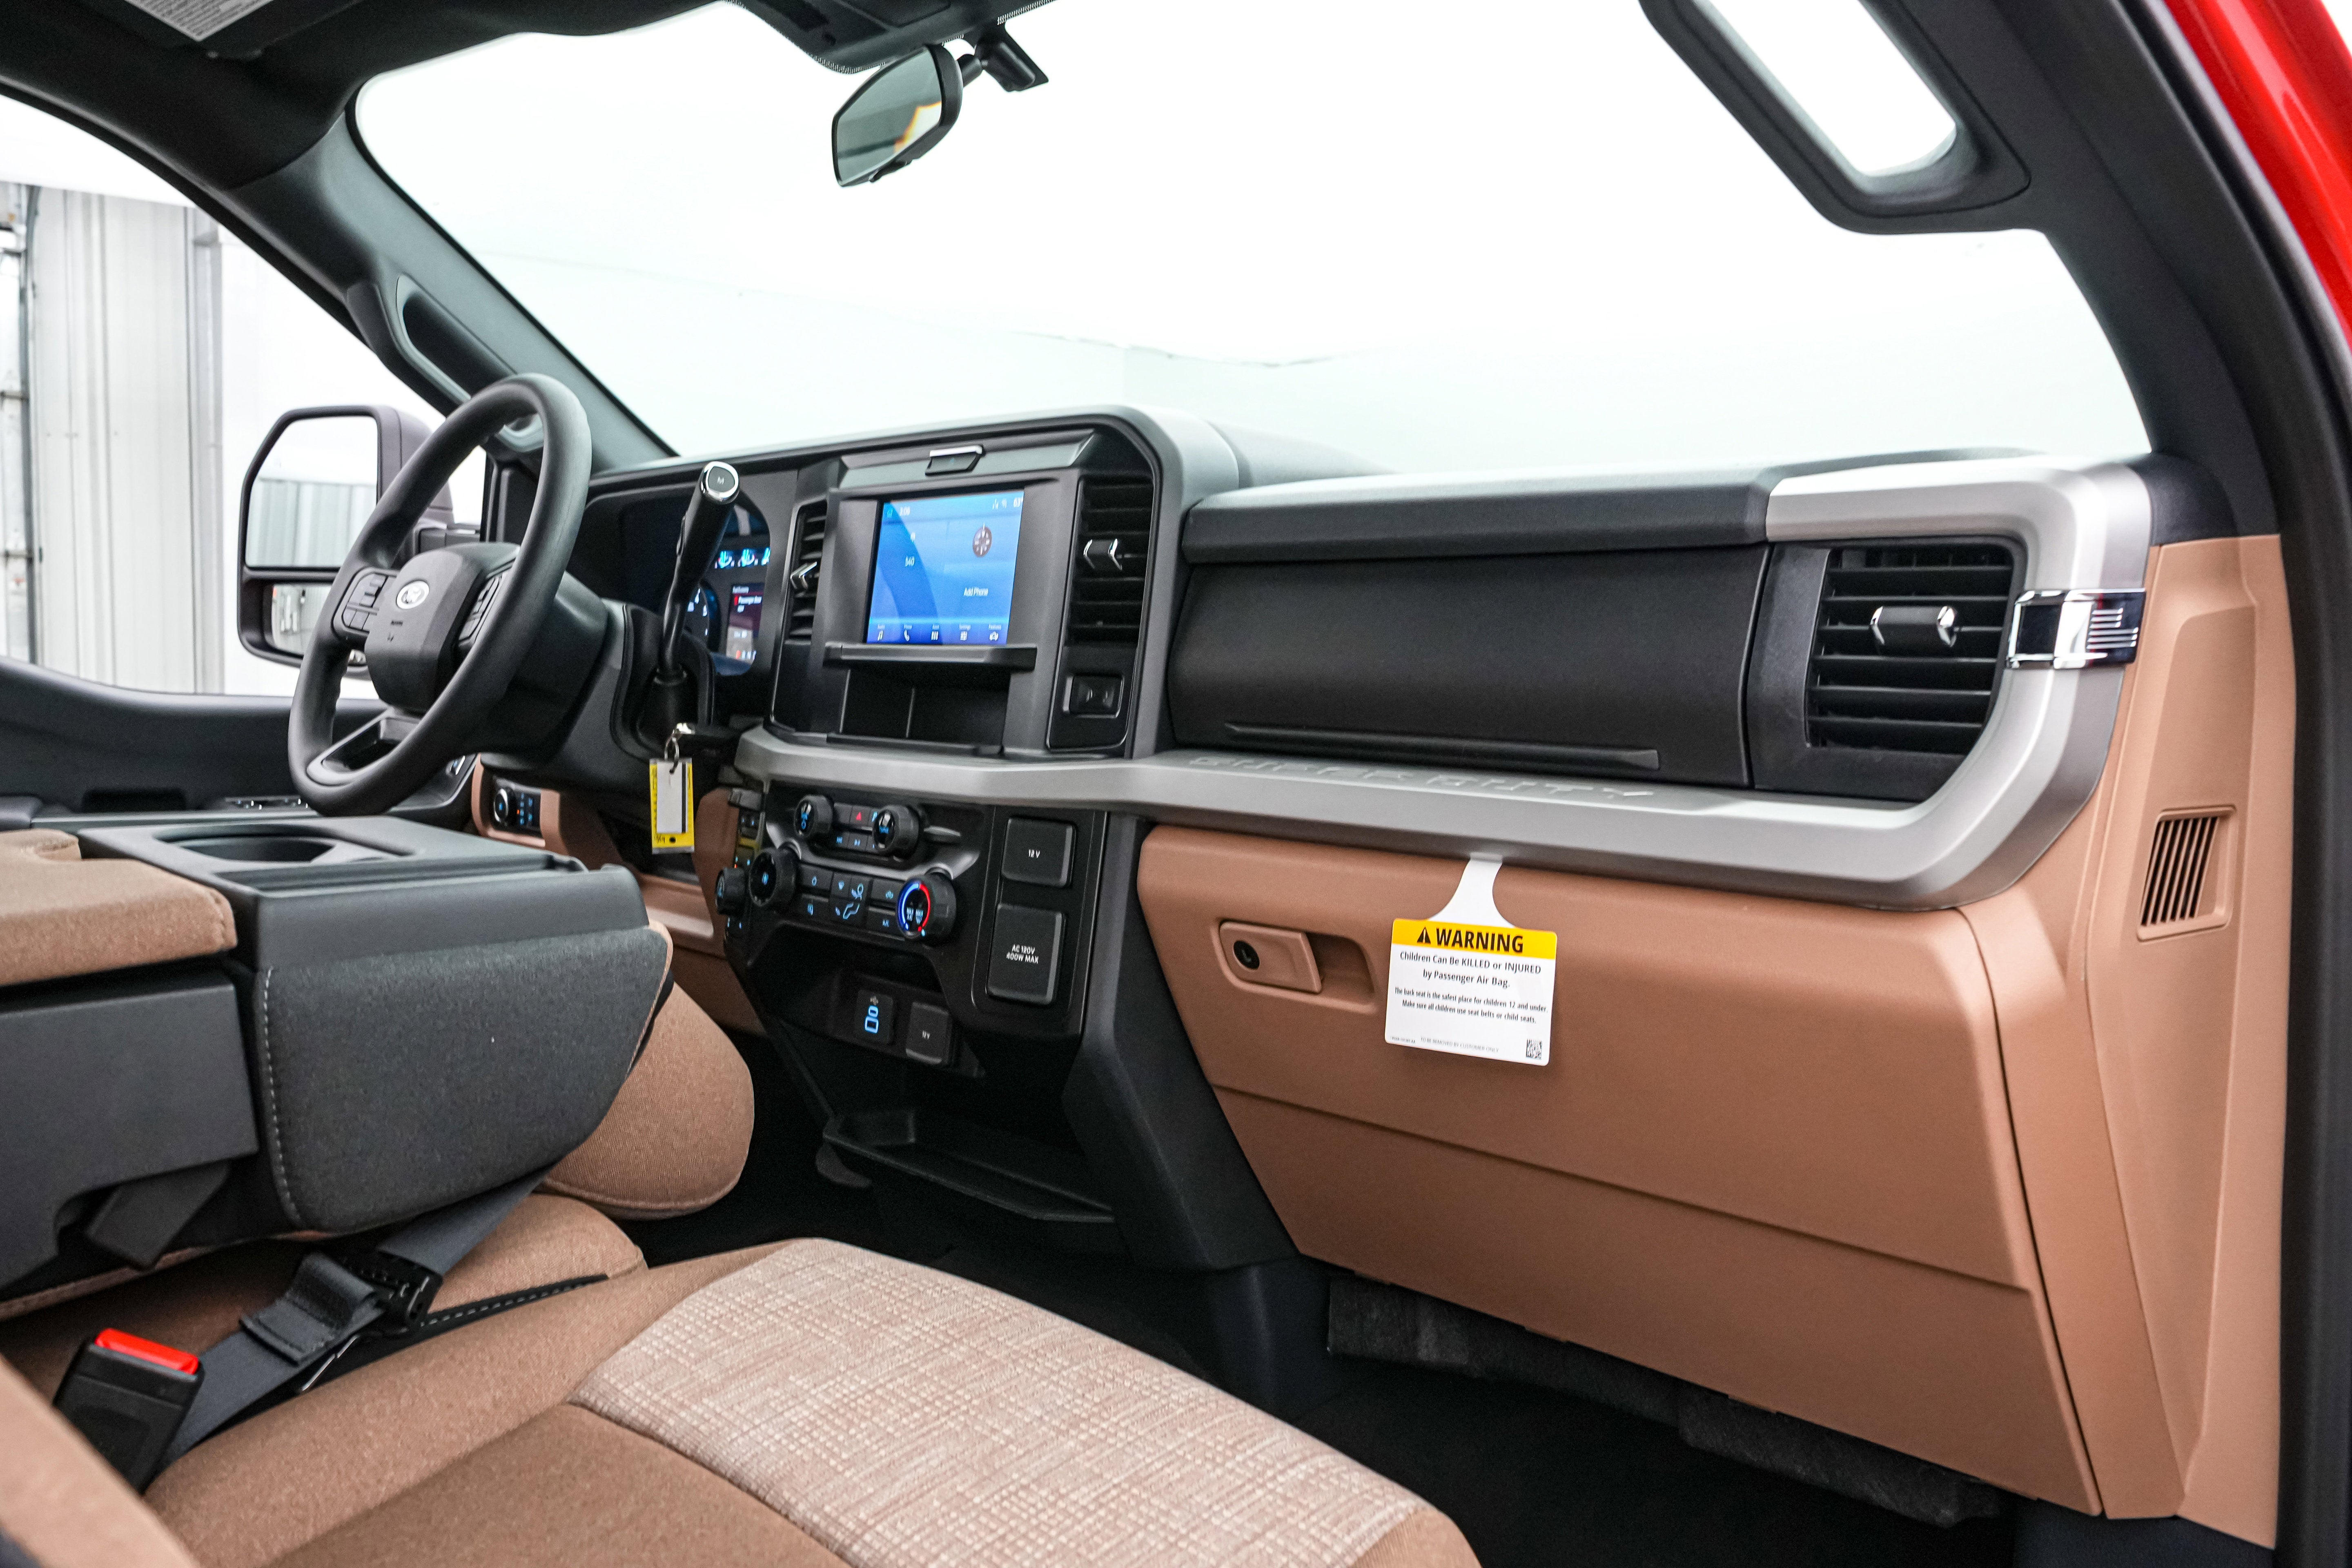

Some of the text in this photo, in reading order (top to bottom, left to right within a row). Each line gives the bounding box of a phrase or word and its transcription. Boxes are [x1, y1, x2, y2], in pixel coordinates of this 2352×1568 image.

[964, 587, 988, 596] Add Phone
[1012, 944, 1035, 955] AC 120V
[1436, 927, 1523, 953] WARNING
[1006, 952, 1039, 964] 400W MAX
[1400, 951, 1430, 962] Children
[1433, 955, 1447, 964] Can
[1450, 957, 1459, 965] Be
[1462, 958, 1490, 969] KILLED
[1505, 962, 1541, 974] INJURED
[1423, 968, 1510, 989] by Passenger Air Bag.
[1404, 987, 1414, 996] back
[1427, 990, 1431, 998] is
[1458, 994, 1472, 1004] place
[1483, 998, 1507, 1007] children
[1402, 999, 1415, 1008] Make
[1435, 1004, 1455, 1013] children
[1481, 1009, 1494, 1018] belts
[1504, 1012, 1518, 1021] child
[1460, 1043, 1485, 1051] CUSTOMER
